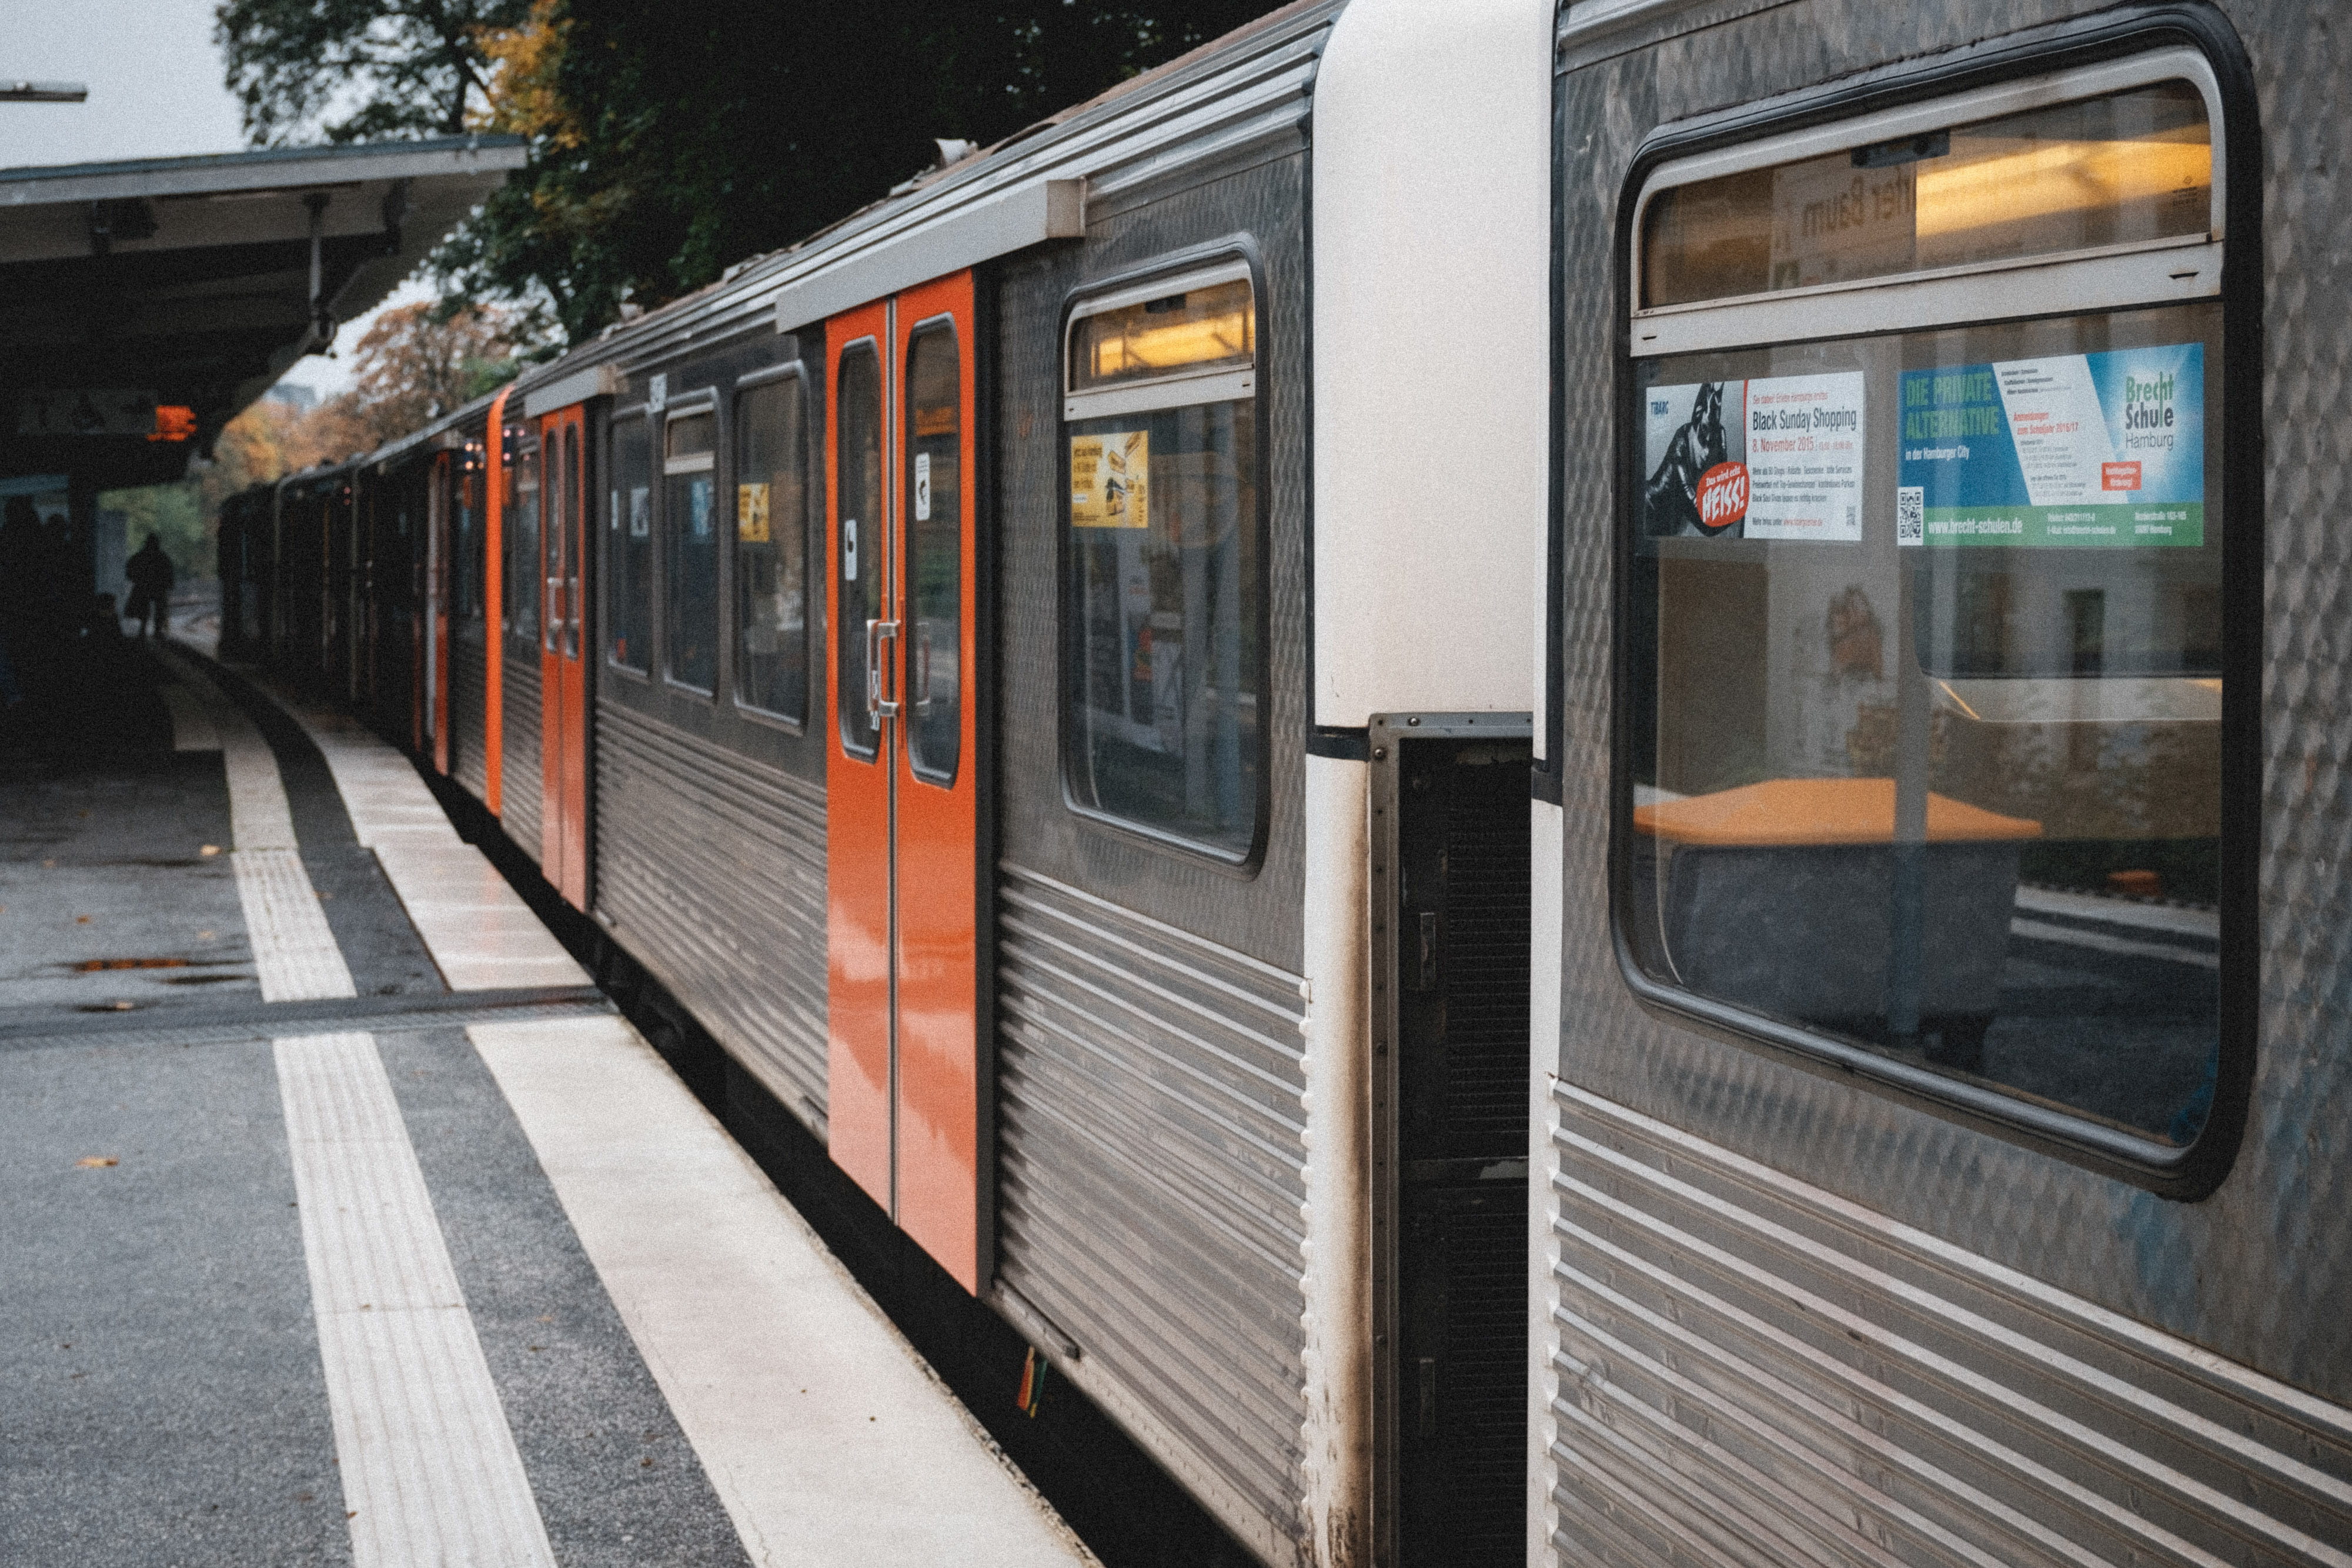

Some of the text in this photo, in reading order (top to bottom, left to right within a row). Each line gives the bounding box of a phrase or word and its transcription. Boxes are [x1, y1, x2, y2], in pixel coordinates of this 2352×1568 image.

[1906, 372, 1992, 406] DIE PRIVATE
[2126, 371, 2174, 403] Brecht
[1753, 406, 1856, 433] Black Sunday Shopping
[1906, 406, 1999, 439] ALTERNATIVE
[2126, 402, 2174, 430] Schule
[1752, 439, 1759, 452] 8.
[1761, 437, 1796, 452] November
[1798, 436, 1814, 452] 2015
[1912, 447, 1922, 460] der
[1923, 446, 1957, 461] Hamburger
[1957, 445, 1970, 460] City
[2126, 432, 2174, 451] Hamburg
[1706, 477, 1716, 486] Das
[1717, 469, 1729, 482] wird
[1730, 466, 1740, 477] echt
[1702, 476, 1745, 523] HEISS!
[1928, 517, 2023, 534] www.brecht-schulen.de
